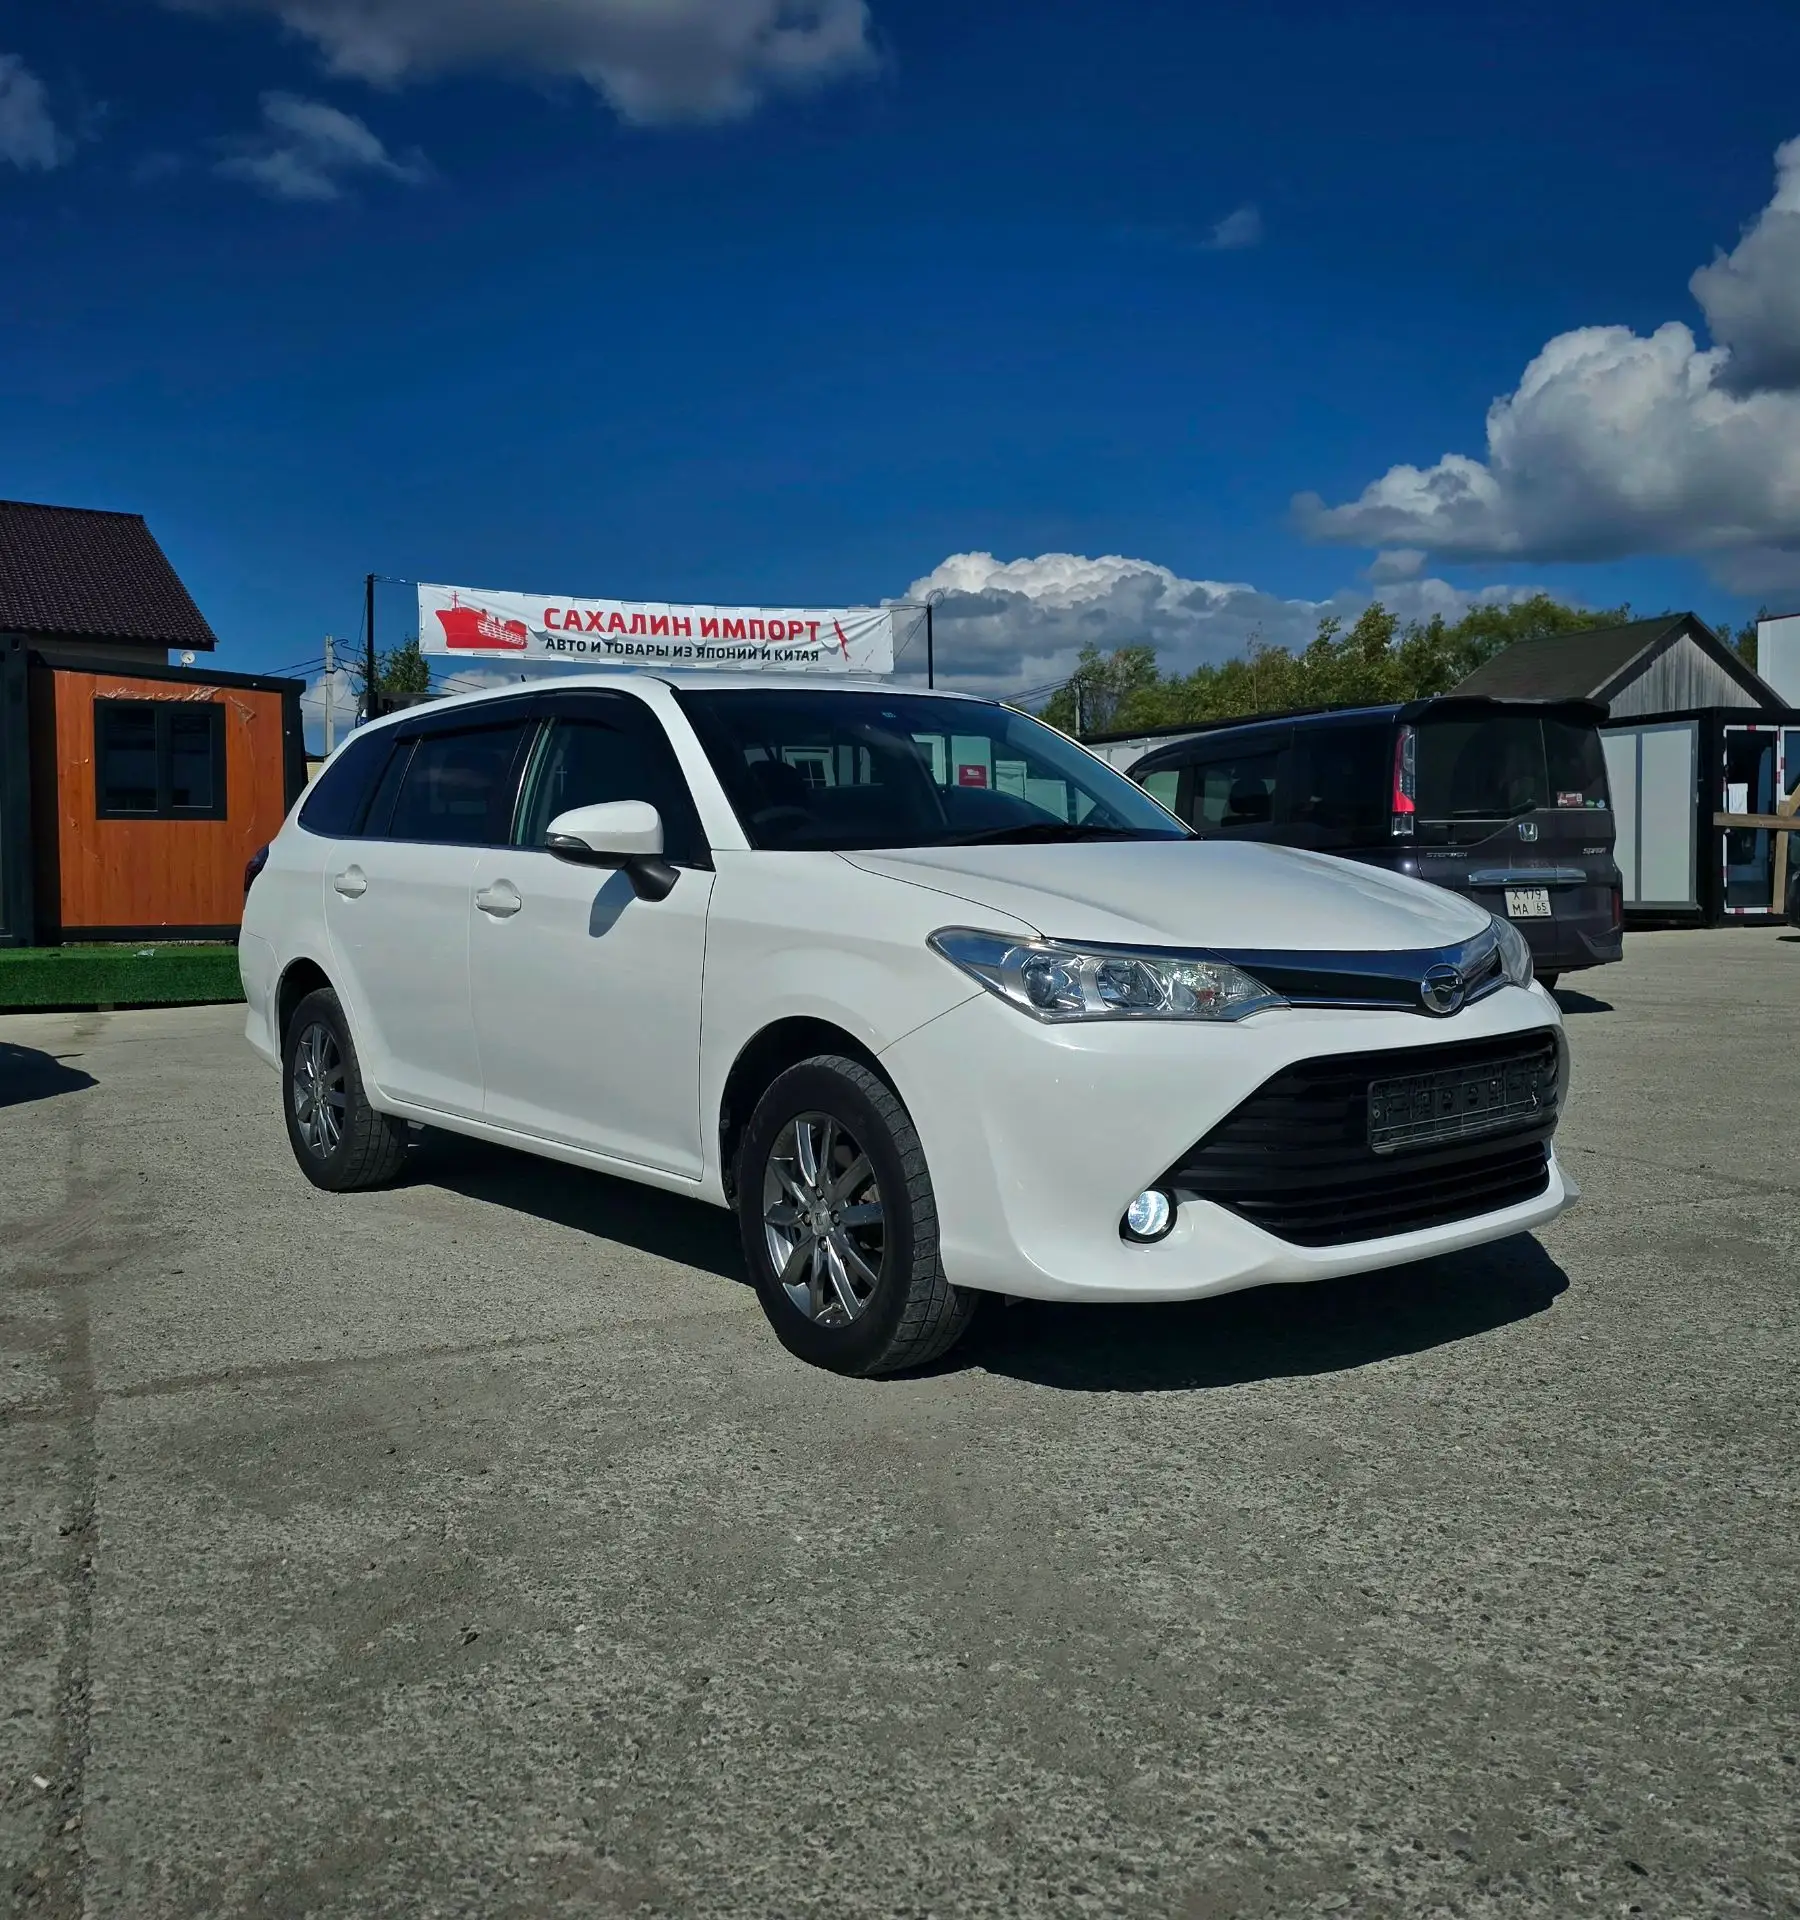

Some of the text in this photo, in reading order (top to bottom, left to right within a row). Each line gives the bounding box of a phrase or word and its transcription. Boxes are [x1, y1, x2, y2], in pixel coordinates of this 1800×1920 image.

[543, 607, 821, 642] САХАЛИН ИМПОРТ
[545, 638, 819, 662] АВТО И ТОВАРЫ ИЗ ЯПОНИИ И КИТАЯ
[1523, 888, 1542, 900] 179
[1536, 902, 1547, 911] 65
